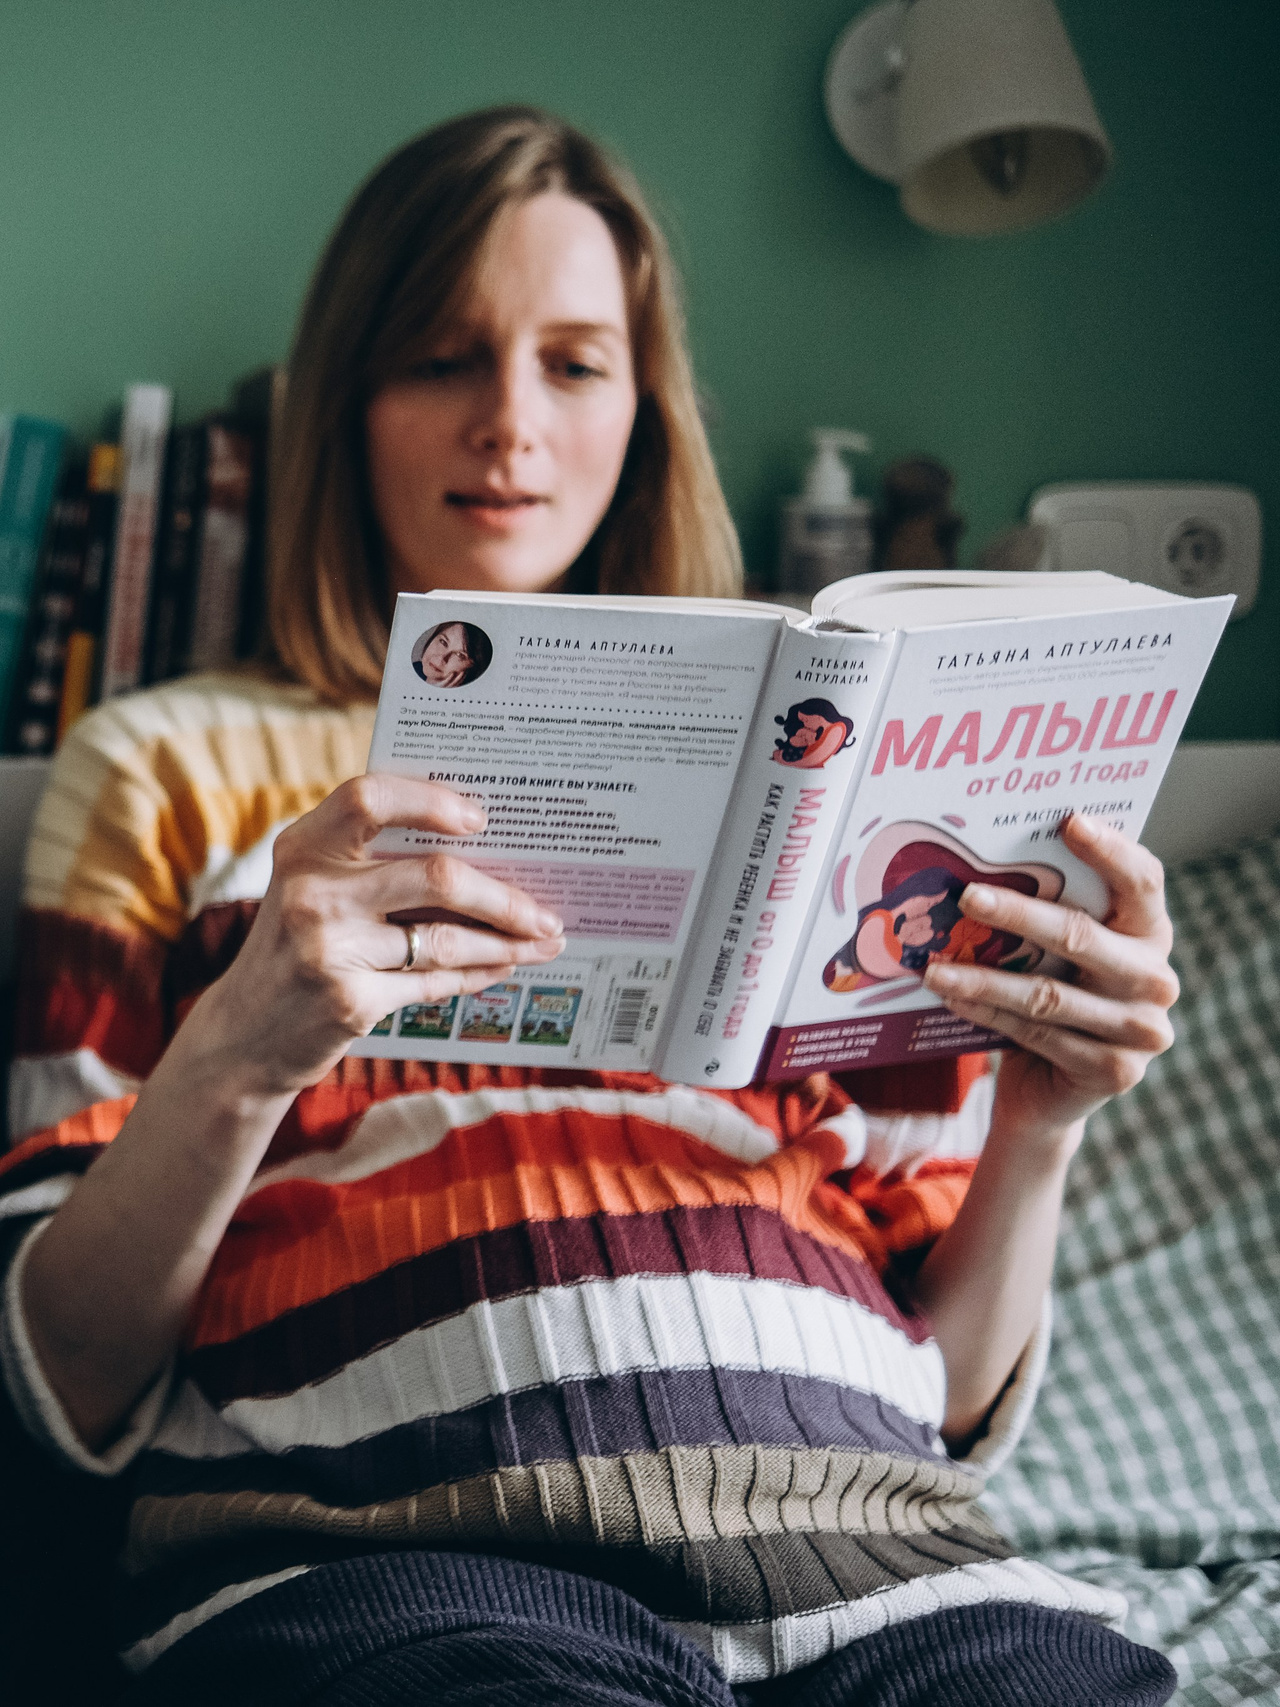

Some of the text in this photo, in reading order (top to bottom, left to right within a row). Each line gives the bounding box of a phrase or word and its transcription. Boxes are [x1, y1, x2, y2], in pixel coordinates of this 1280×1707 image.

[519, 636, 675, 656] ТАТЬЯНА АПТУЛАЕВА
[937, 633, 1173, 670] ТАТЬЯНА АПТУЛАЕВА
[811, 656, 865, 670] ТАТЬЯНА
[795, 669, 869, 685] АПТУЛАЕВА
[870, 688, 1179, 776] МАЛЫШ
[428, 772, 636, 792] БЛАГОДАРЯ ЭТОЙ КНИГЕ ВЫ УЗНАЕТЕ:
[966, 776, 1000, 797] от
[1023, 770, 1061, 794] до
[1069, 760, 1083, 784] 1
[1083, 759, 1150, 784] года
[992, 813, 1019, 829] КАК
[766, 786, 827, 901] МАЛЫШ
[756, 911, 777, 934] от
[741, 952, 763, 979] до
[722, 993, 750, 1040] года
